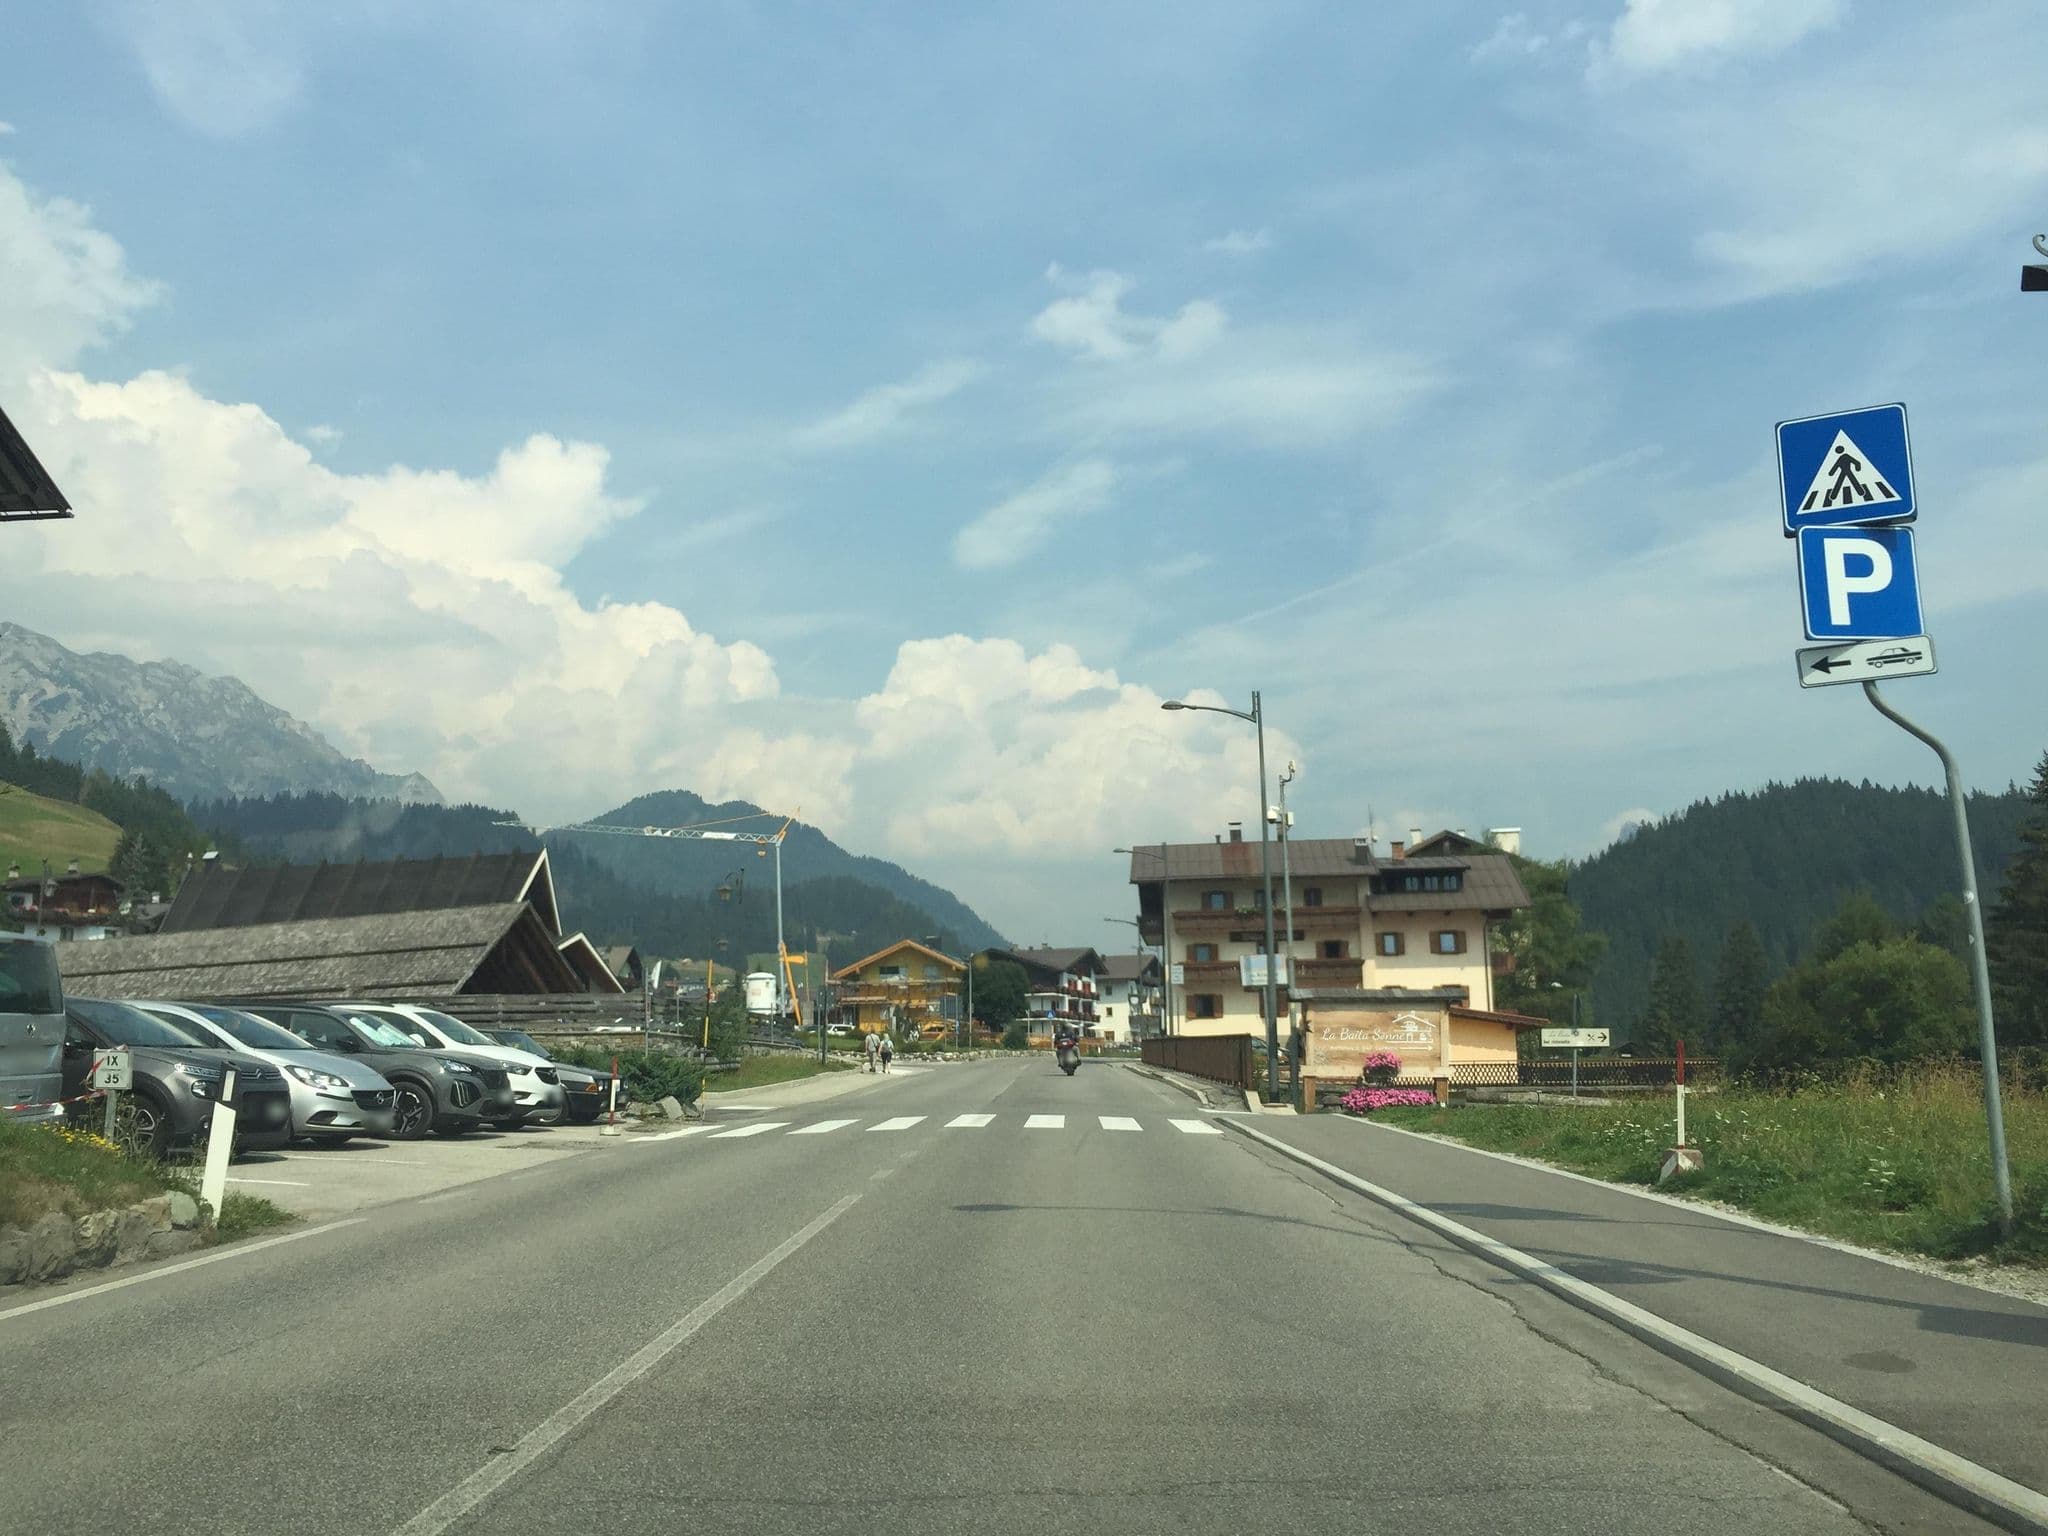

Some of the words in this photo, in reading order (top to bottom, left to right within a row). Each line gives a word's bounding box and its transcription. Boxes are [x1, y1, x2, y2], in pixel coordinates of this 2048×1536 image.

[1824, 537, 1893, 626] P
[1322, 1027, 1336, 1041] La
[1340, 1027, 1368, 1041] Baita
[106, 1055, 119, 1066] IX
[104, 1074, 119, 1084] 35
